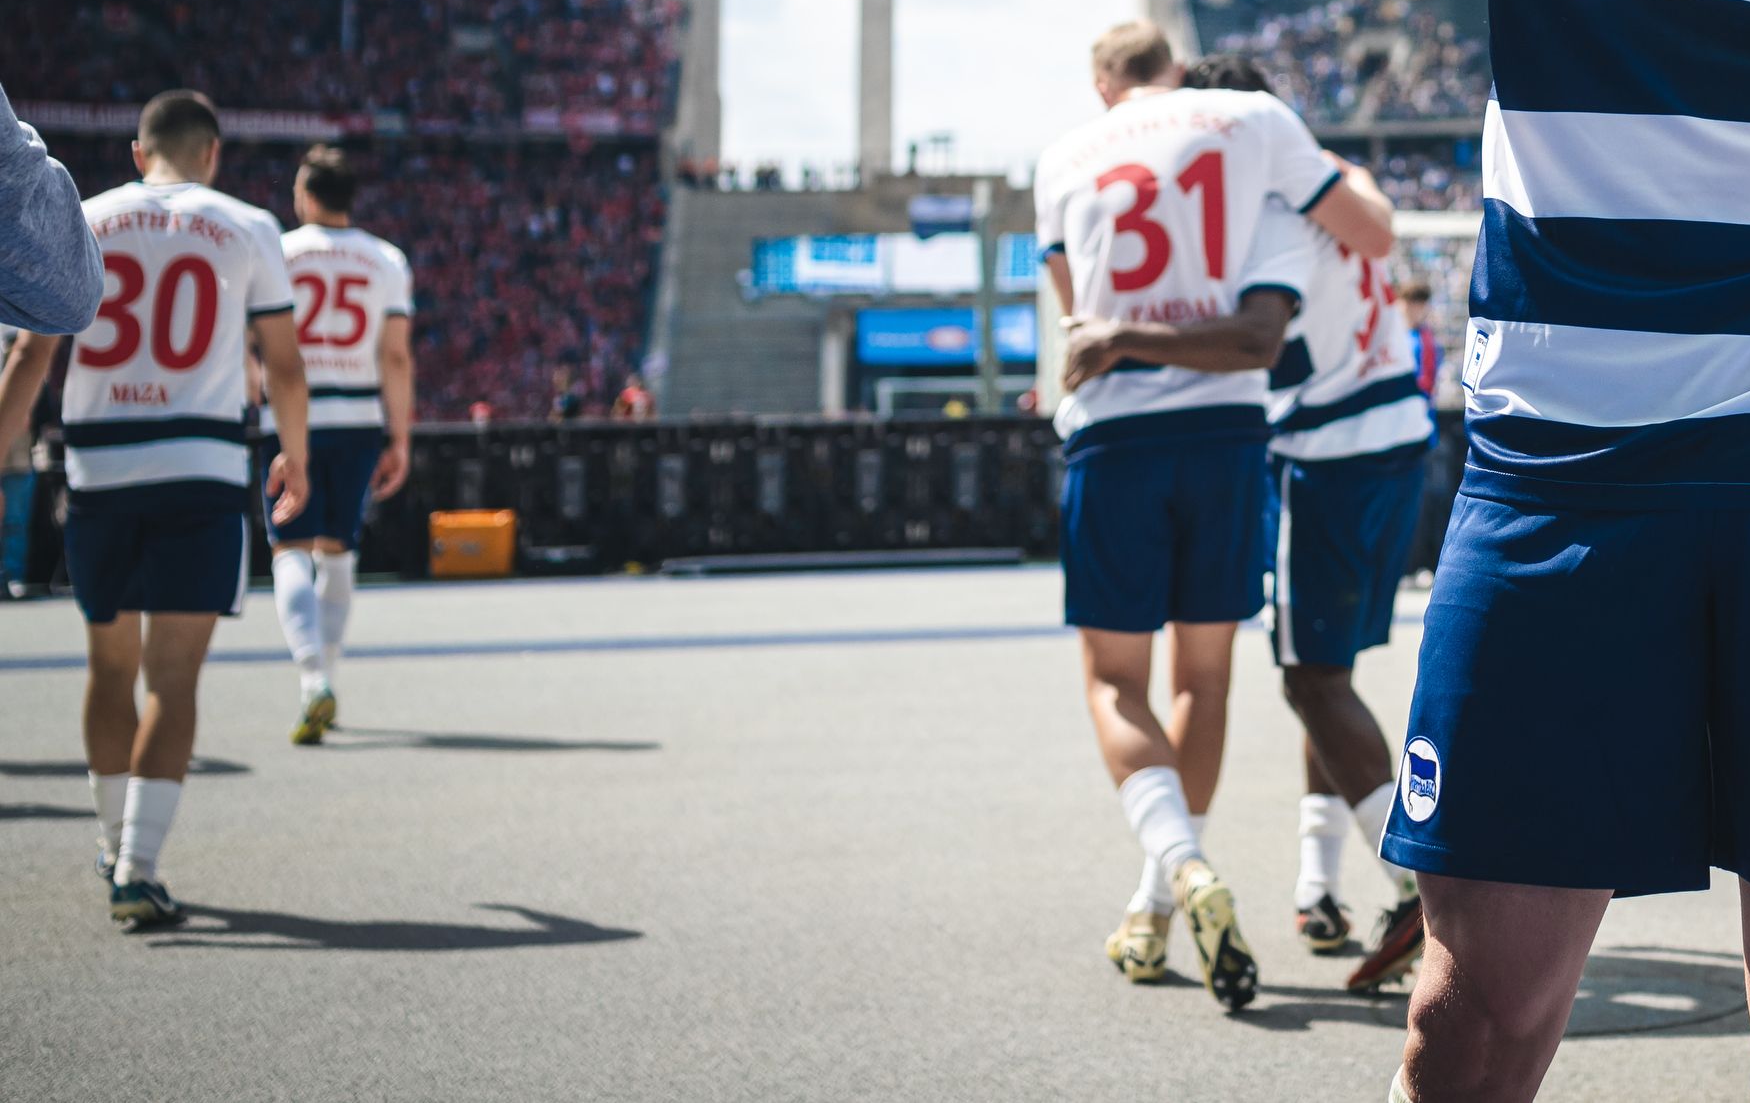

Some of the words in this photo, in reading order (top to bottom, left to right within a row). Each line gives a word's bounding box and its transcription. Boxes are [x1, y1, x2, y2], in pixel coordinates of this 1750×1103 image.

[1095, 149, 1226, 293] 31
[77, 251, 218, 372] 30
[293, 272, 370, 347] 25
[110, 382, 169, 406] MAZA
